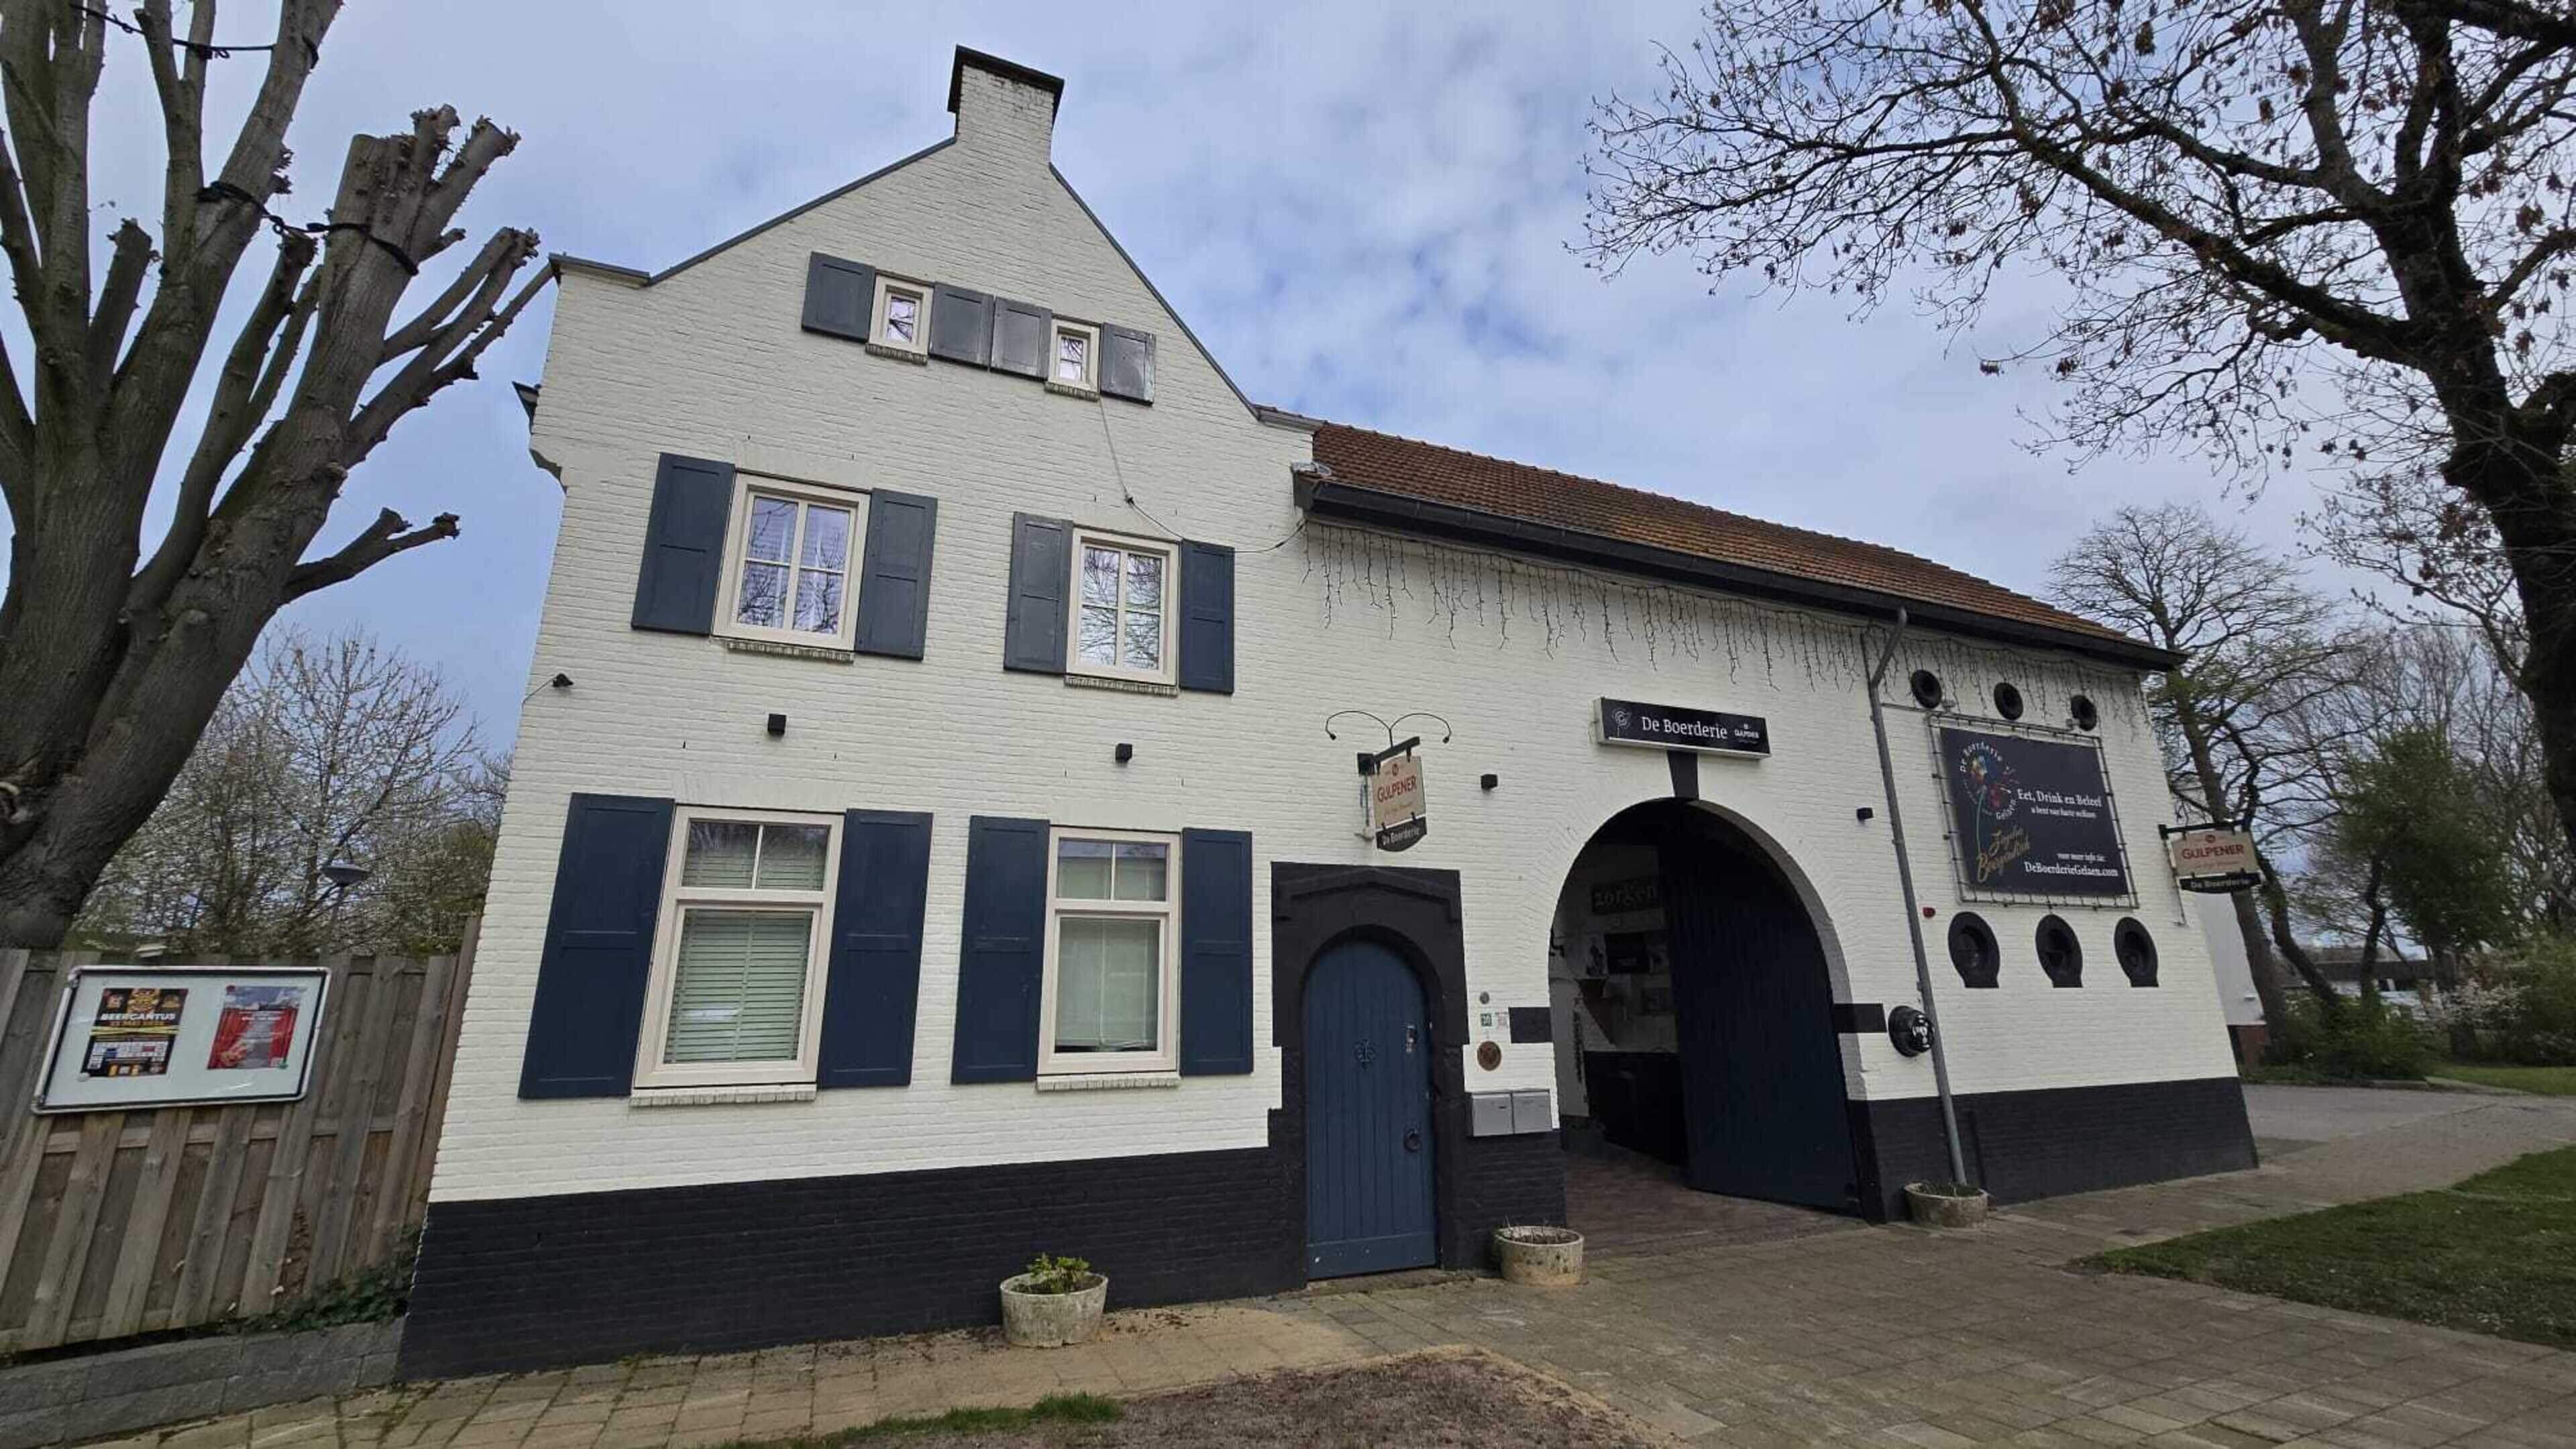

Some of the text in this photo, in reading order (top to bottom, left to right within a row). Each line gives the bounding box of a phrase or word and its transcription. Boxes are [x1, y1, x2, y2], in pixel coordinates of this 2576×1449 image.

[1642, 716, 1728, 739] De Boerderie
[1377, 775, 1417, 802] GULPENER
[2017, 788, 2102, 807] Eet, Drink en Beleef
[2182, 844, 2245, 859] GULPENER
[101, 1012, 176, 1020] BEERCANTUS
